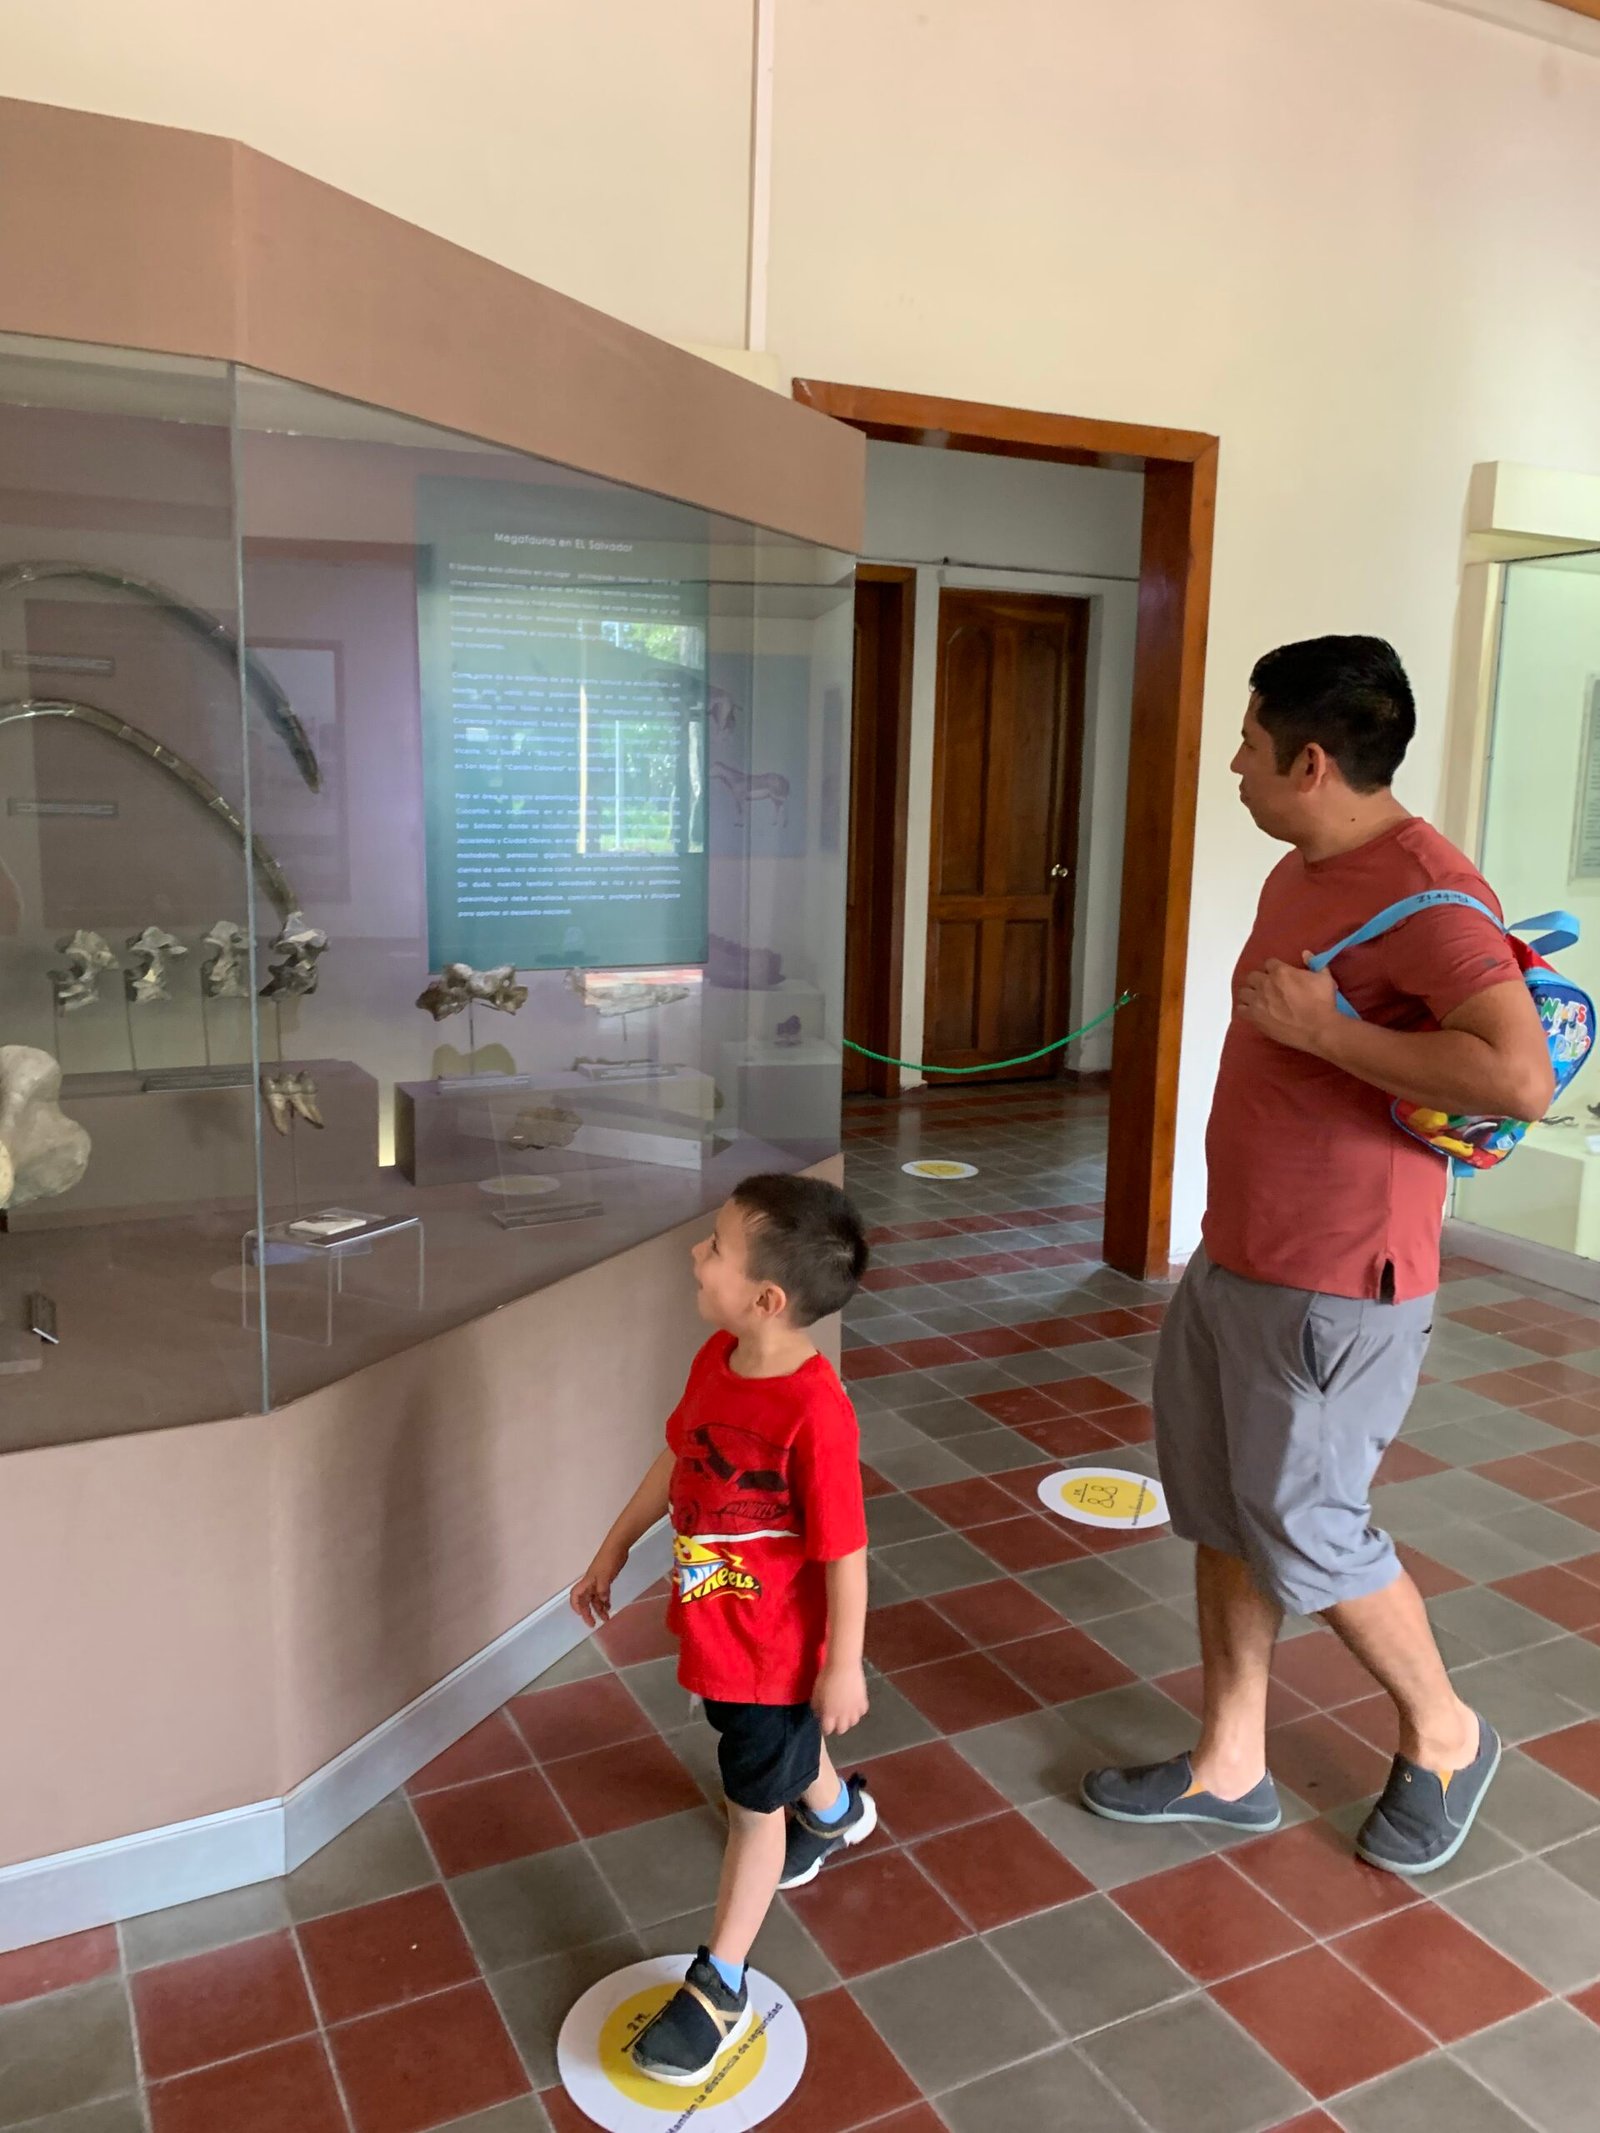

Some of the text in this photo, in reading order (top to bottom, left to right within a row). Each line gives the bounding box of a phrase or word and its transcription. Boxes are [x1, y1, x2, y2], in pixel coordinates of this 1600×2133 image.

[494, 532, 557, 546] Megafauna
[558, 539, 573, 548] en
[588, 540, 633, 552] Salvador
[695, 2093, 708, 2104] la
[704, 2054, 740, 2094] distancia
[738, 2042, 751, 2055] de
[748, 2002, 783, 2045] seguridad
